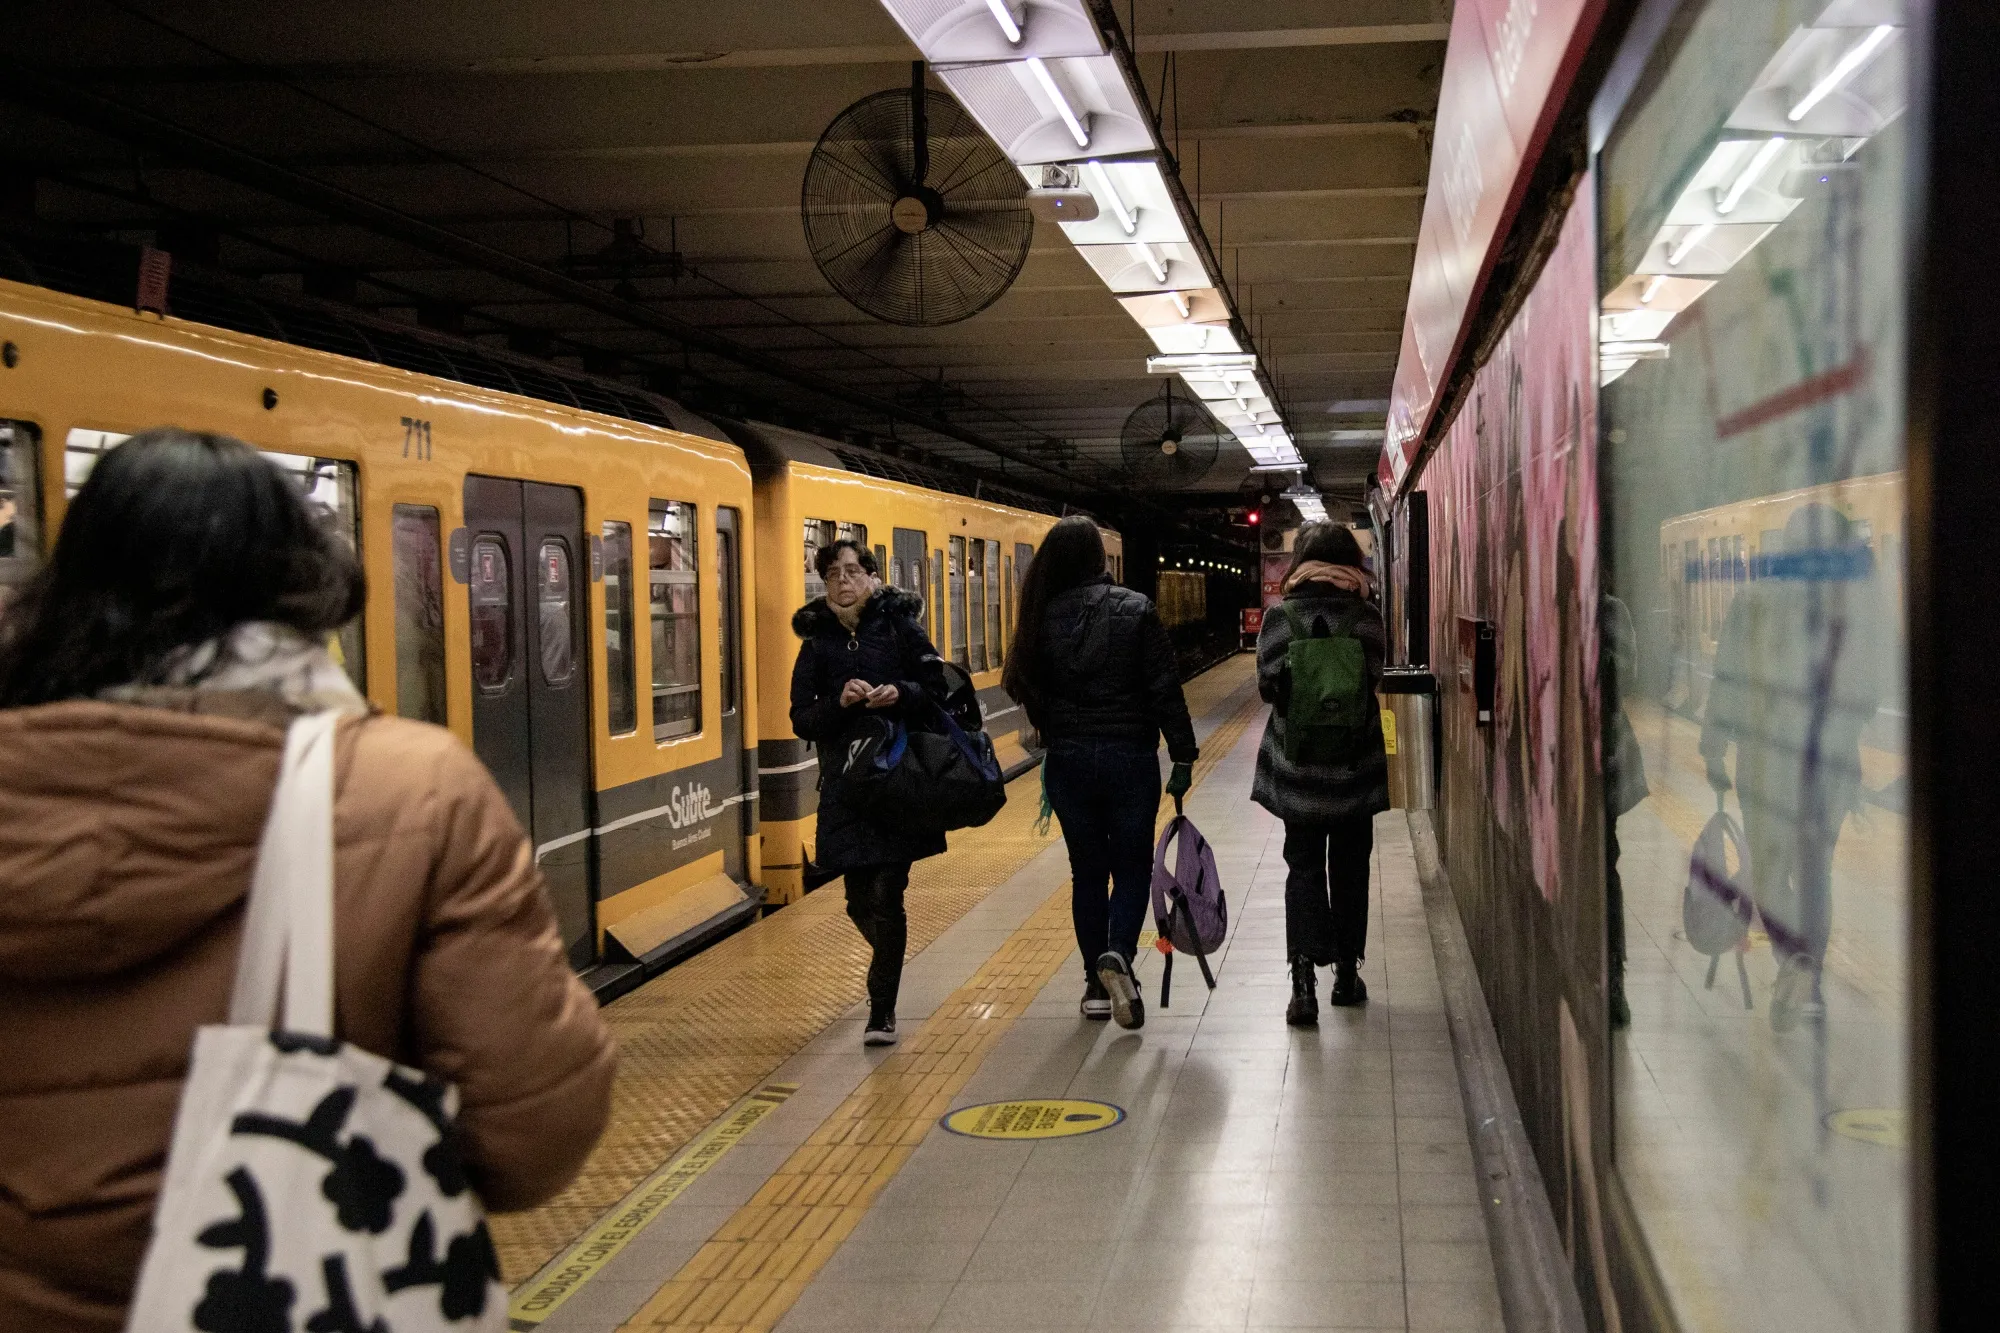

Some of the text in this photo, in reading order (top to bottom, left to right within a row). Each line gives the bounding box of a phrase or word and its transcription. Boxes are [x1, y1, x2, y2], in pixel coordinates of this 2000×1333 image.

[400, 416, 431, 461] 711
[668, 782, 714, 829] Subte
[720, 1126, 746, 1135] EL
[692, 1141, 730, 1159] TREN
[680, 1160, 709, 1169] EL
[653, 1170, 698, 1193] ENTRE
[612, 1193, 668, 1229] ESPACIO
[601, 1229, 632, 1240] EL
[577, 1242, 617, 1263] CON
[521, 1264, 592, 1311] CUIDADO
